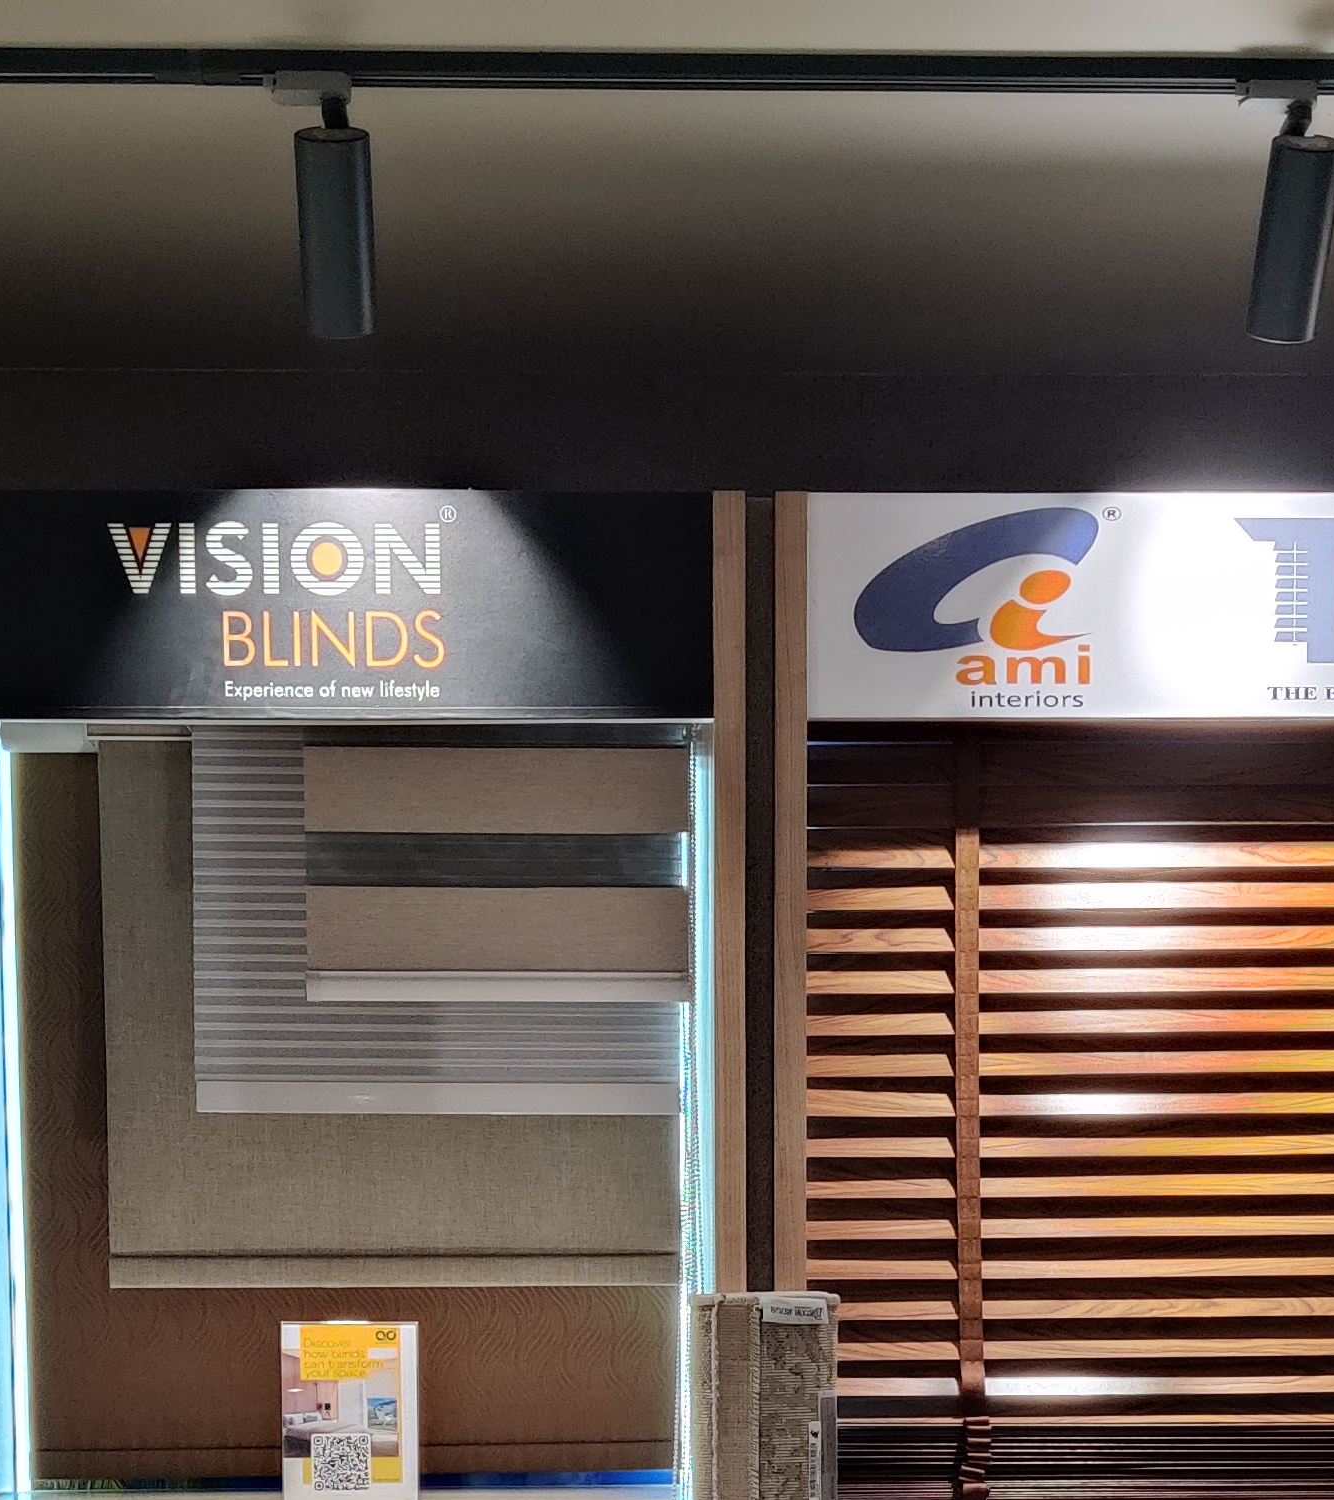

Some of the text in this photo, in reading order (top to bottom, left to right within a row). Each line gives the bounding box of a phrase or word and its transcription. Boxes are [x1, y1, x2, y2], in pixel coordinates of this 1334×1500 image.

[107, 520, 442, 597] VISION
[222, 609, 446, 669] BLINDS
[955, 644, 1091, 686] ami
[224, 680, 441, 701] Experience of new lifestyle
[1267, 686, 1318, 701] THE
[970, 690, 1084, 709] interiors
[303, 1338, 351, 1349] Discover
[303, 1349, 366, 1359] how blinds
[304, 1359, 384, 1369] can transform
[304, 1369, 367, 1379] your space
